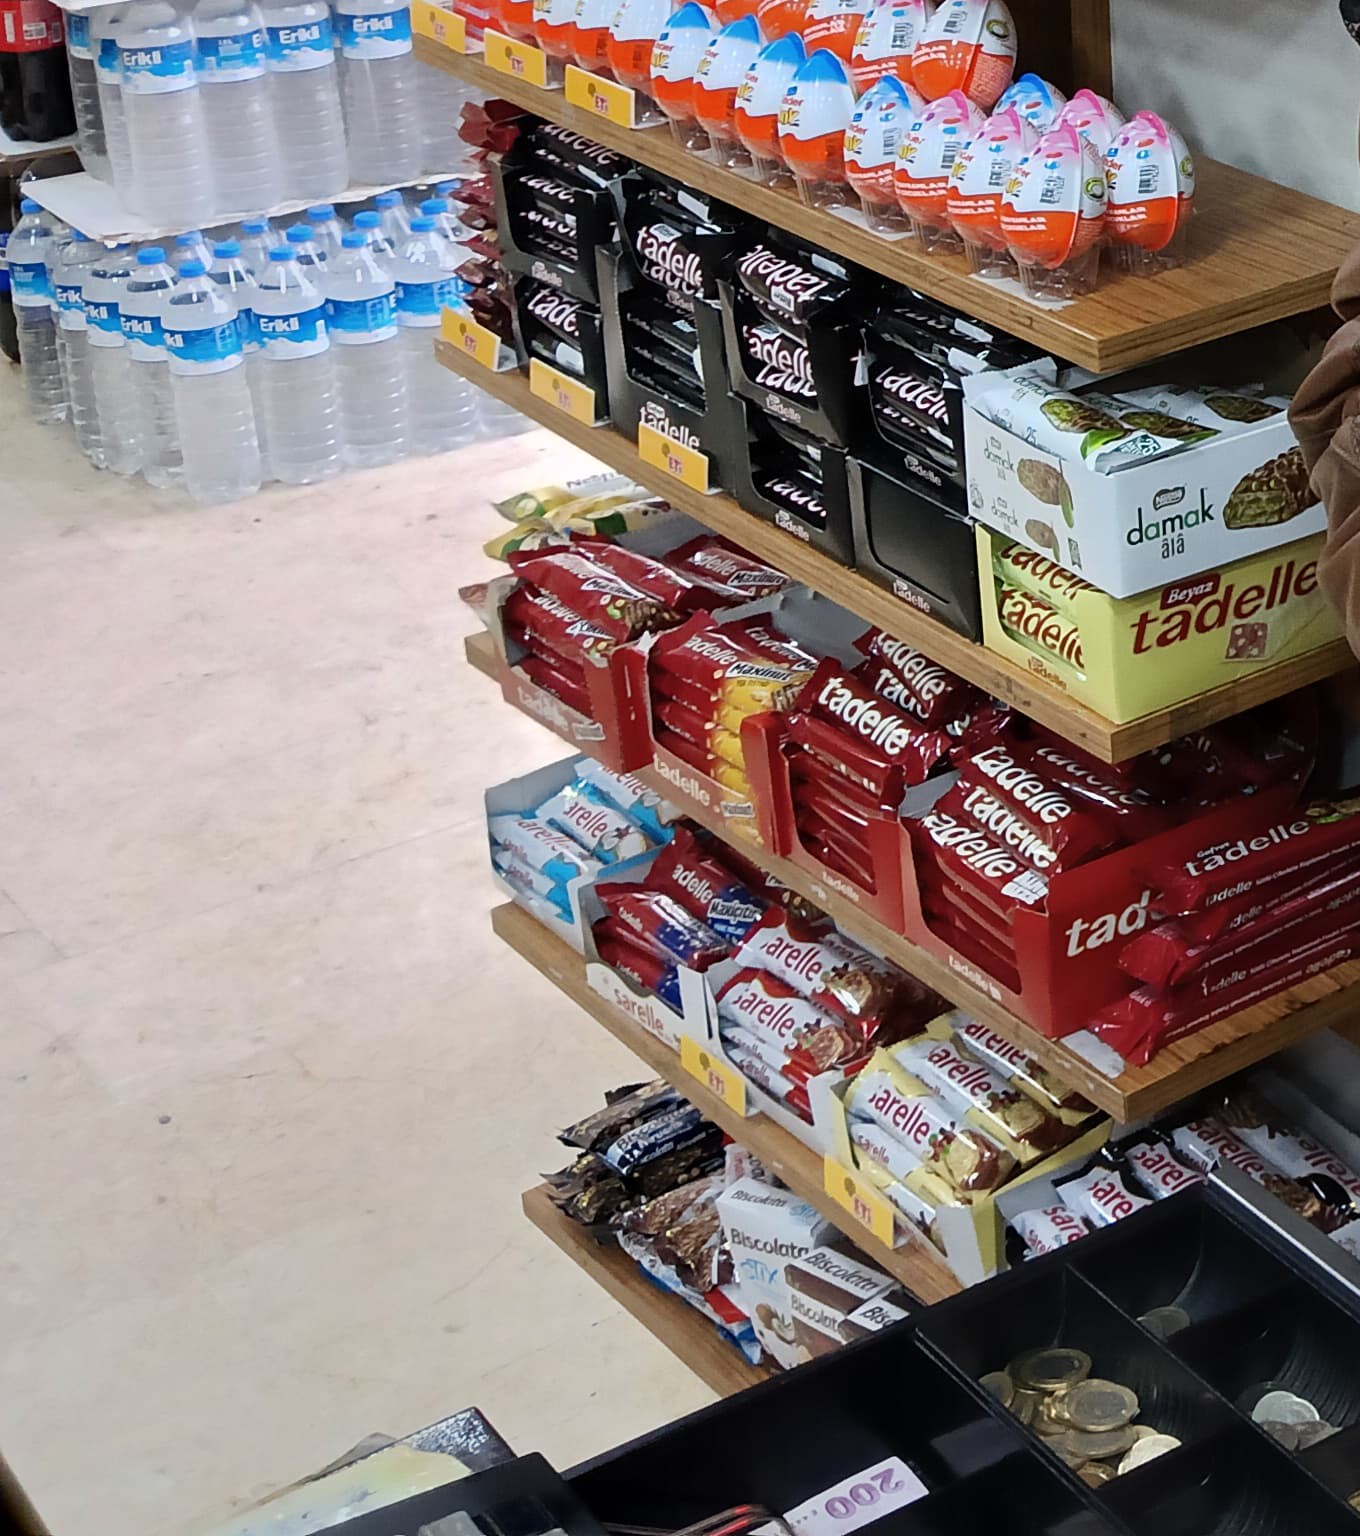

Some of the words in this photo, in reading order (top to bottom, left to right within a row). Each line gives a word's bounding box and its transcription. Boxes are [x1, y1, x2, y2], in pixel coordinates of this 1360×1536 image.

[278, 26, 321, 44] Erikli
[352, 14, 394, 33] Erikli
[122, 50, 162, 68] Erikli
[259, 316, 300, 334] Erikli
[1126, 488, 1215, 547] damak
[1160, 534, 1186, 560] âlâ
[1131, 561, 1318, 655] tadelle
[1166, 578, 1214, 604] Beyaz
[817, 677, 912, 756] tadelle
[652, 756, 711, 806] tadelle
[970, 745, 1073, 824] tadelle
[1185, 819, 1310, 877] tadelle
[613, 986, 666, 1032] sarelle
[730, 1228, 809, 1261] Biscolata
[806, 1251, 880, 1293] Biscolata
[824, 1468, 905, 1519] 200
